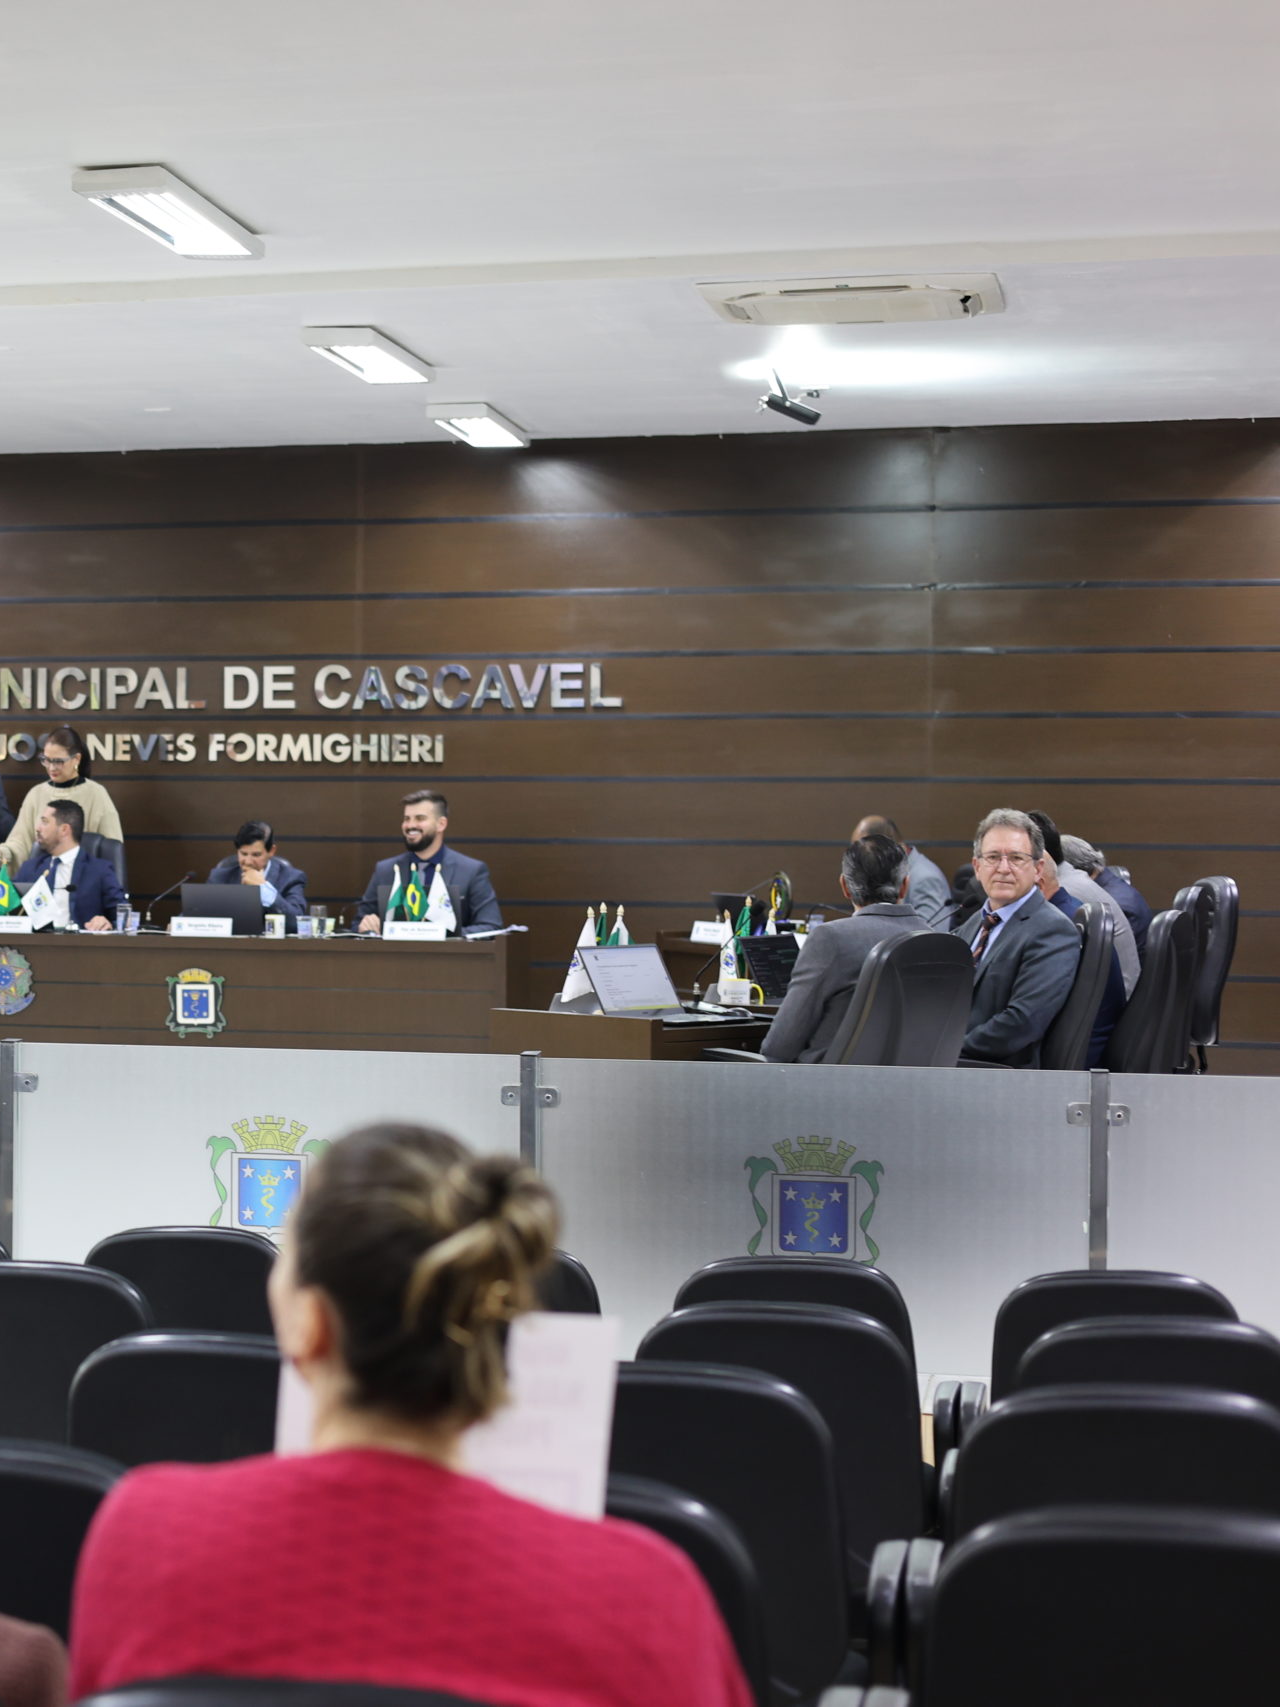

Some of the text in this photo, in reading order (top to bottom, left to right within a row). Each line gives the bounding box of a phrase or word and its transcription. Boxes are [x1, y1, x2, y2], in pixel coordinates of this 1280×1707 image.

[223, 665, 296, 711] DE
[313, 662, 624, 711] CASCAVEL
[86, 733, 197, 763] NEVES
[208, 732, 445, 764] FORMIGHIERI
